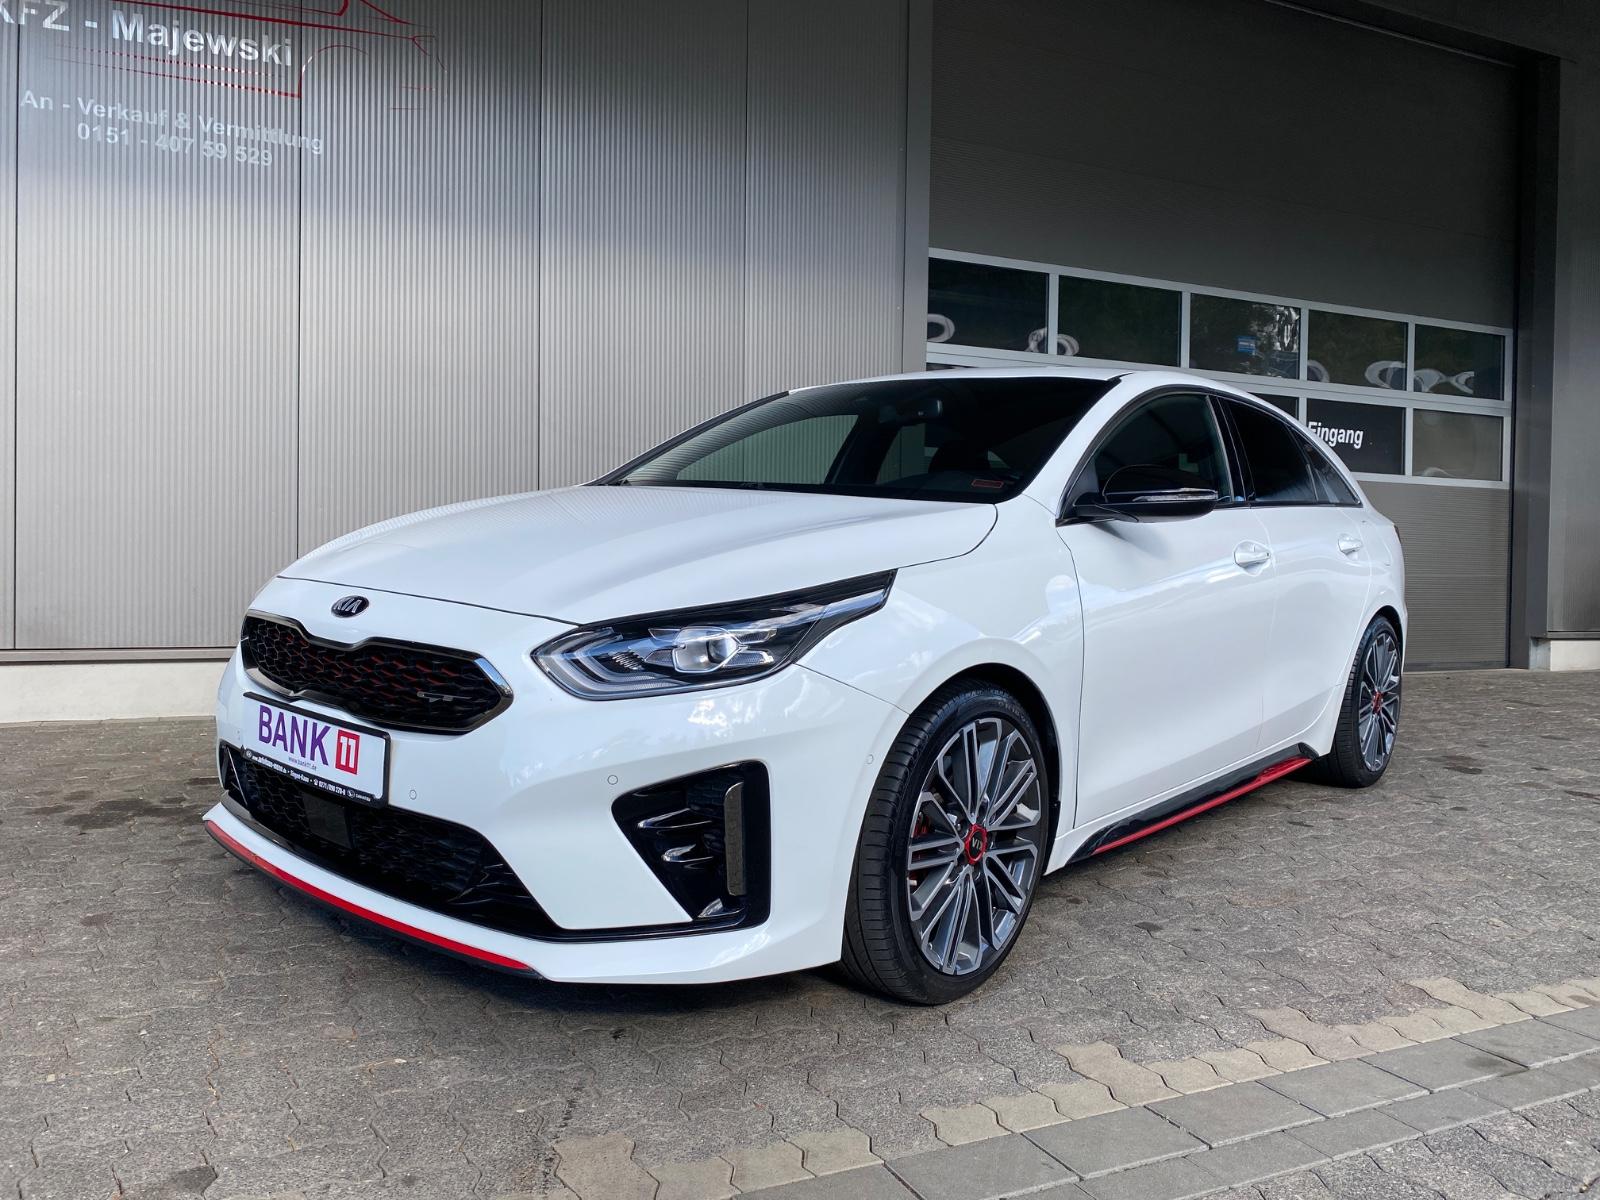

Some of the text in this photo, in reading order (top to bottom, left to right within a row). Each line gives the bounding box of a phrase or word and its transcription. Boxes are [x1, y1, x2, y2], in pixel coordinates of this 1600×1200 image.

[112, 9, 293, 67] Majewski
[20, 89, 53, 111] An
[77, 97, 168, 126] Verkauf
[174, 111, 191, 130] &
[198, 115, 324, 155] Vermittlung
[77, 122, 130, 146] 0151
[154, 135, 194, 154] 407
[202, 141, 228, 159] 59
[235, 145, 273, 167] 529
[1308, 421, 1364, 449] Eingang
[333, 597, 362, 613] KIA
[258, 704, 356, 769] BANK 11
